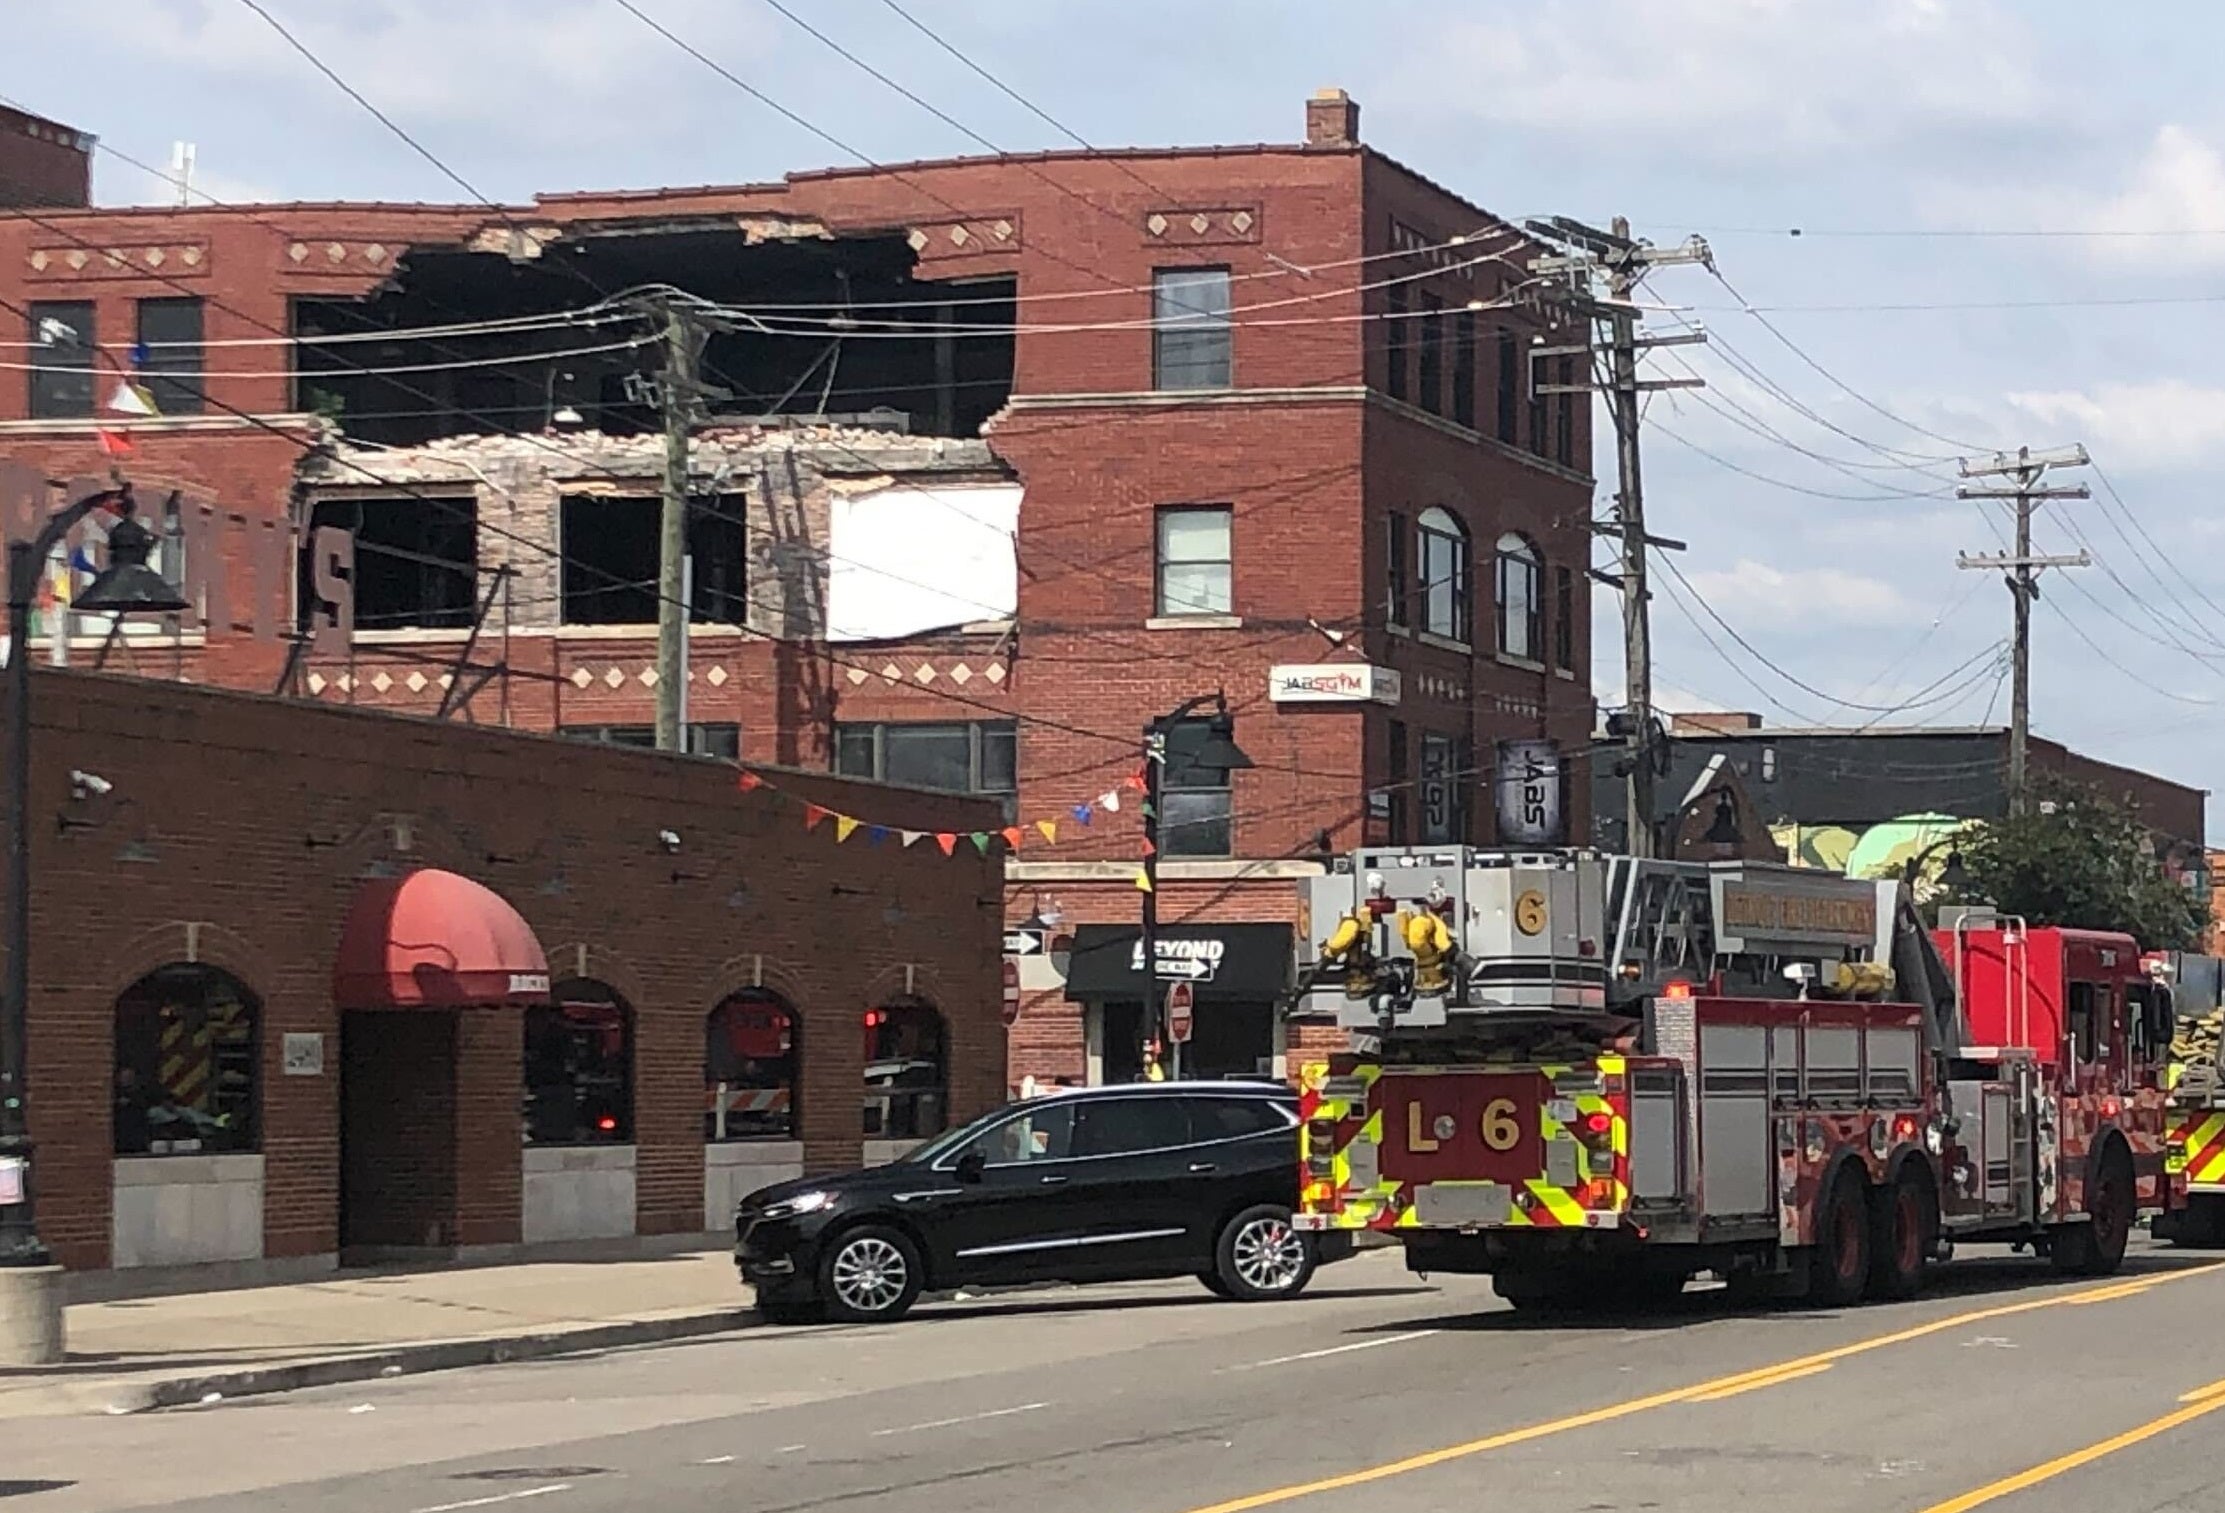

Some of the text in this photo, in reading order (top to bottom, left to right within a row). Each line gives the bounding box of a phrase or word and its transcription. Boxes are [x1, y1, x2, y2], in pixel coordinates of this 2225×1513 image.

[1524, 750, 1546, 828] JABS
[1515, 889, 1547, 937] 6
[1408, 1100, 1520, 1152] L 6
